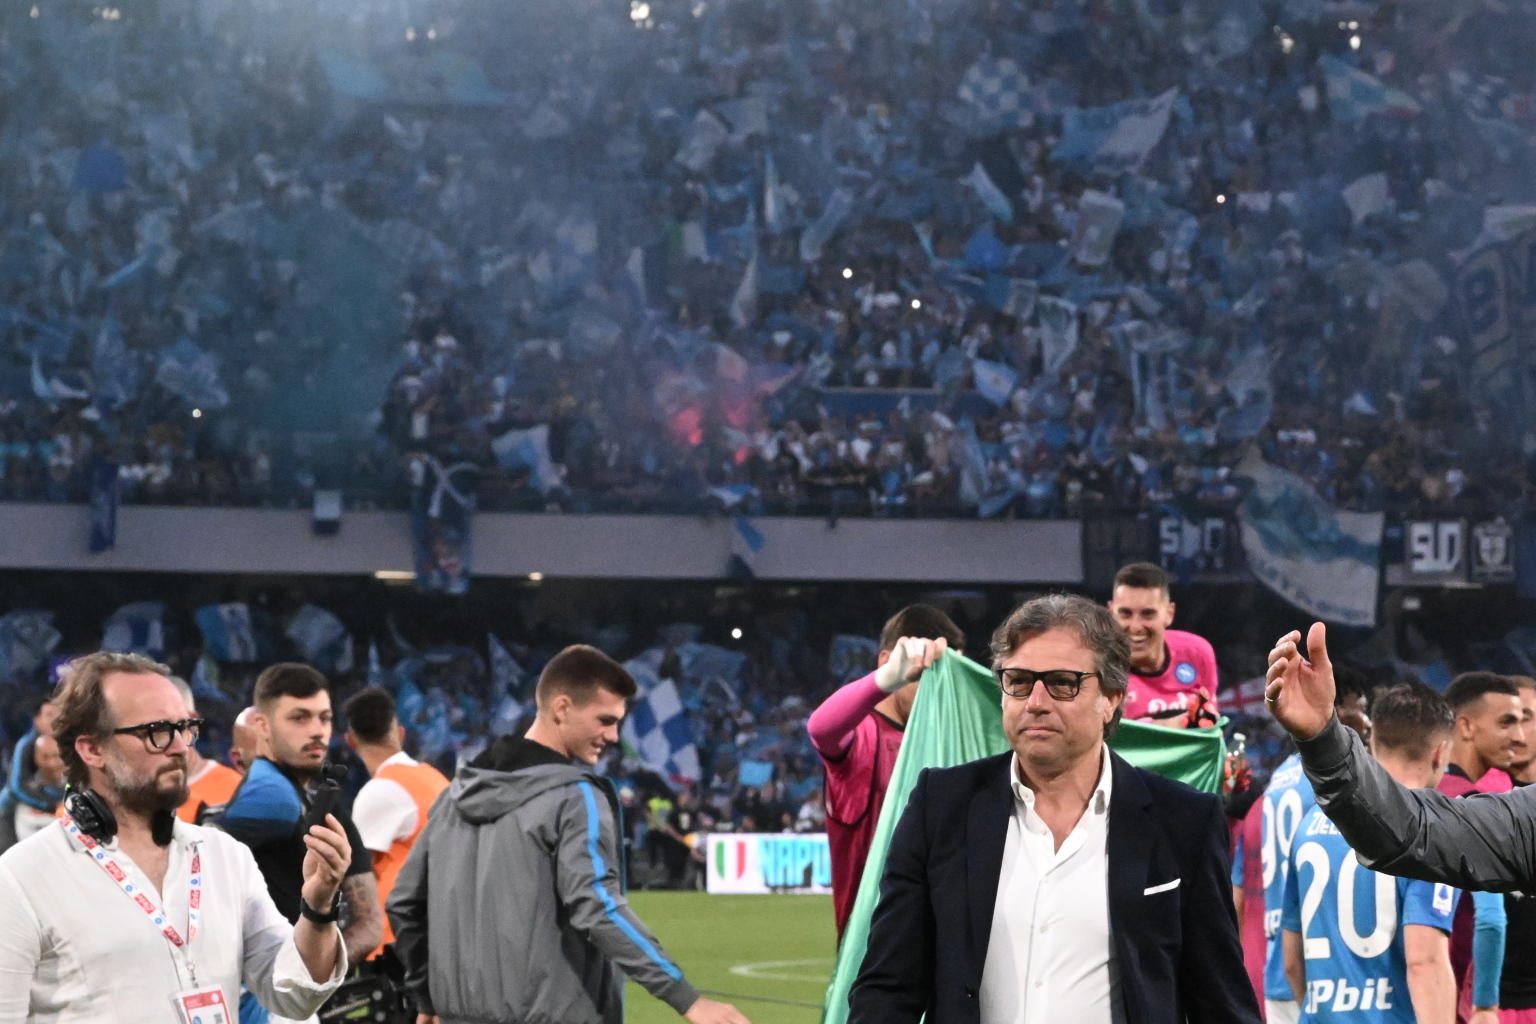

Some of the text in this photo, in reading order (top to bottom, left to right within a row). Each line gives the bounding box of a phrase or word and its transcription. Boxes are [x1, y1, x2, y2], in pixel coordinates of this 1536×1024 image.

[1306, 811, 1341, 836] ZIEL
[1295, 841, 1398, 960] 20
[1304, 977, 1394, 1015] Pbit
